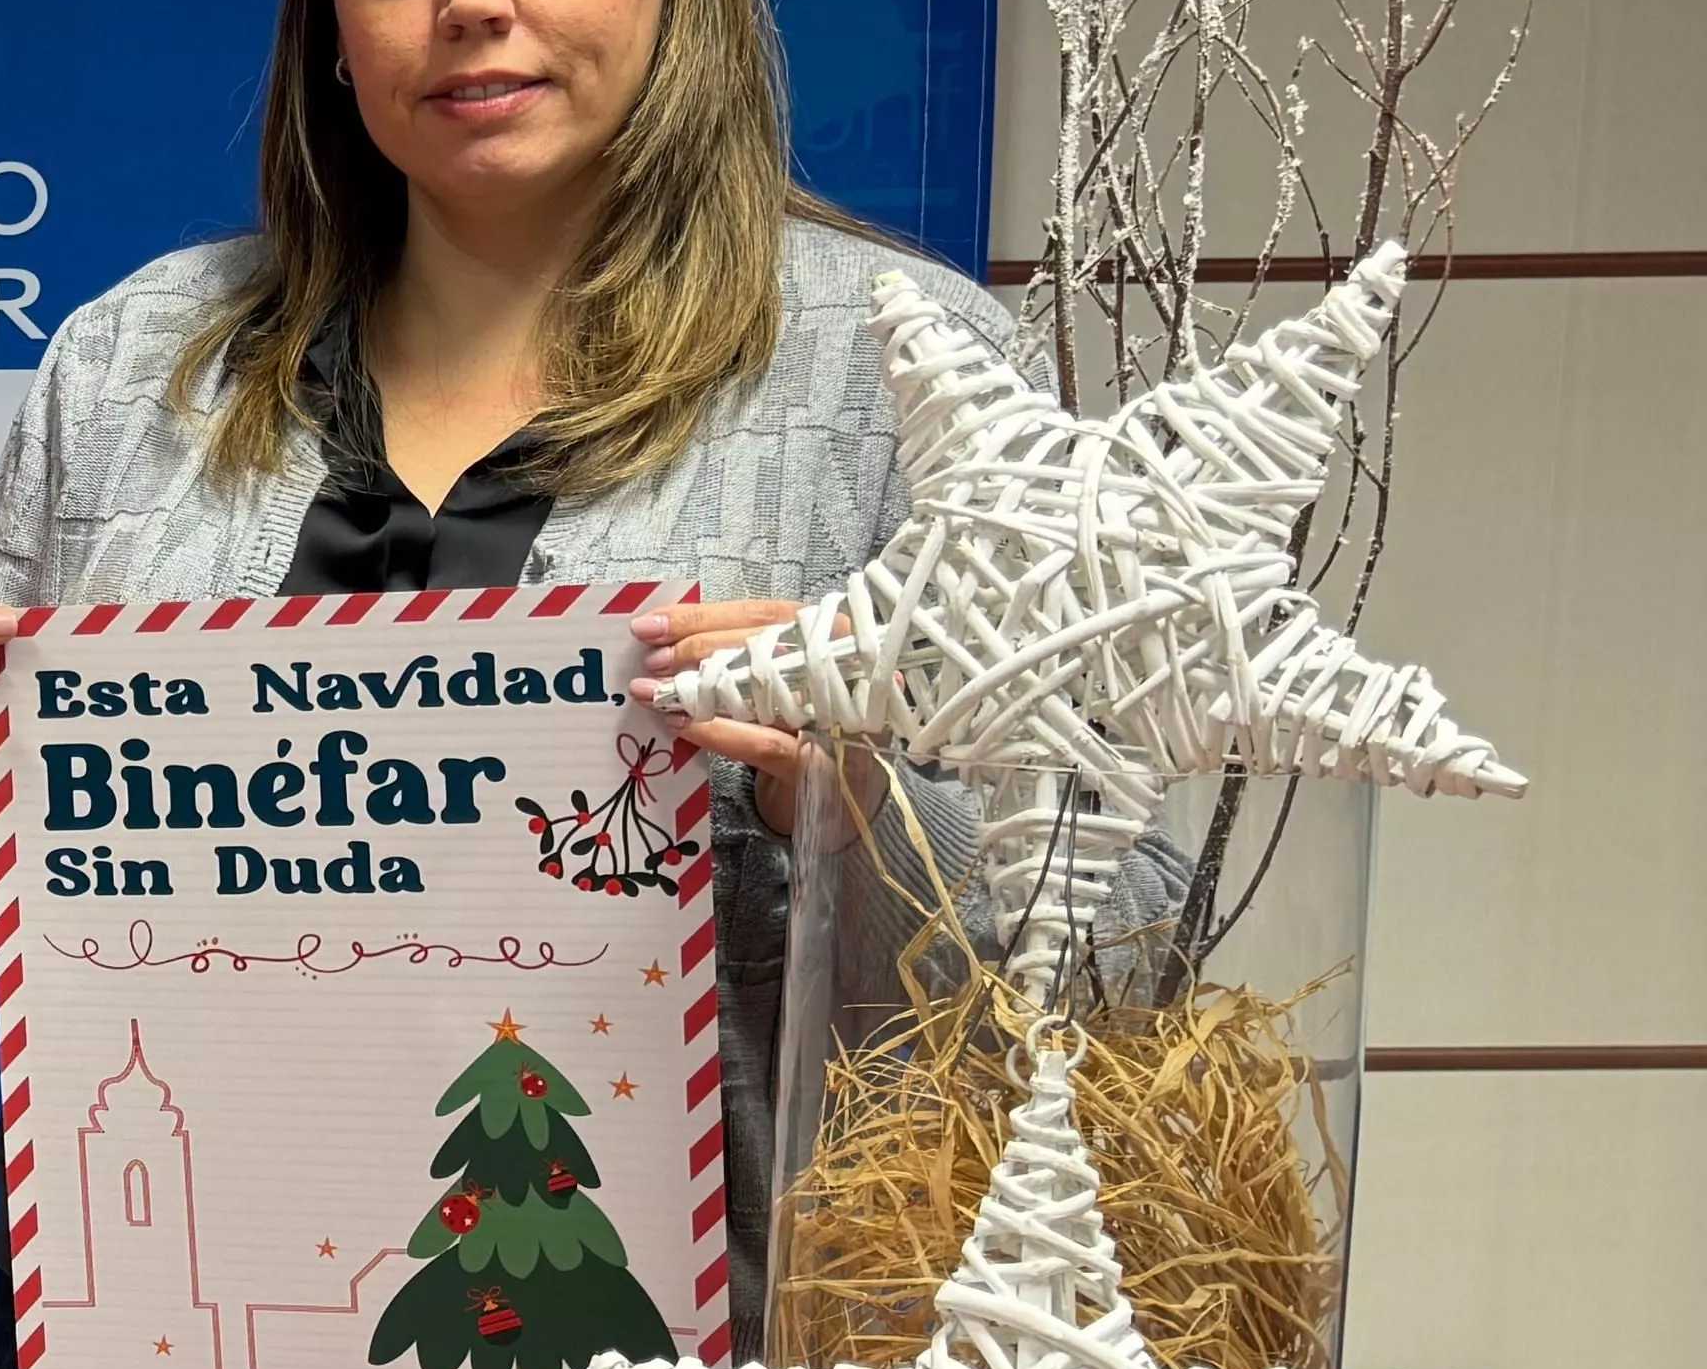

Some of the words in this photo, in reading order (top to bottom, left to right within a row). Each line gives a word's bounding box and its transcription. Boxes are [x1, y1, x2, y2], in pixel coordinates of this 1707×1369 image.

[35, 670, 208, 718] Esta
[250, 648, 633, 712] Navidad,
[40, 730, 505, 830] Binéfar
[45, 846, 173, 896] Sin
[214, 841, 424, 894] Duda
